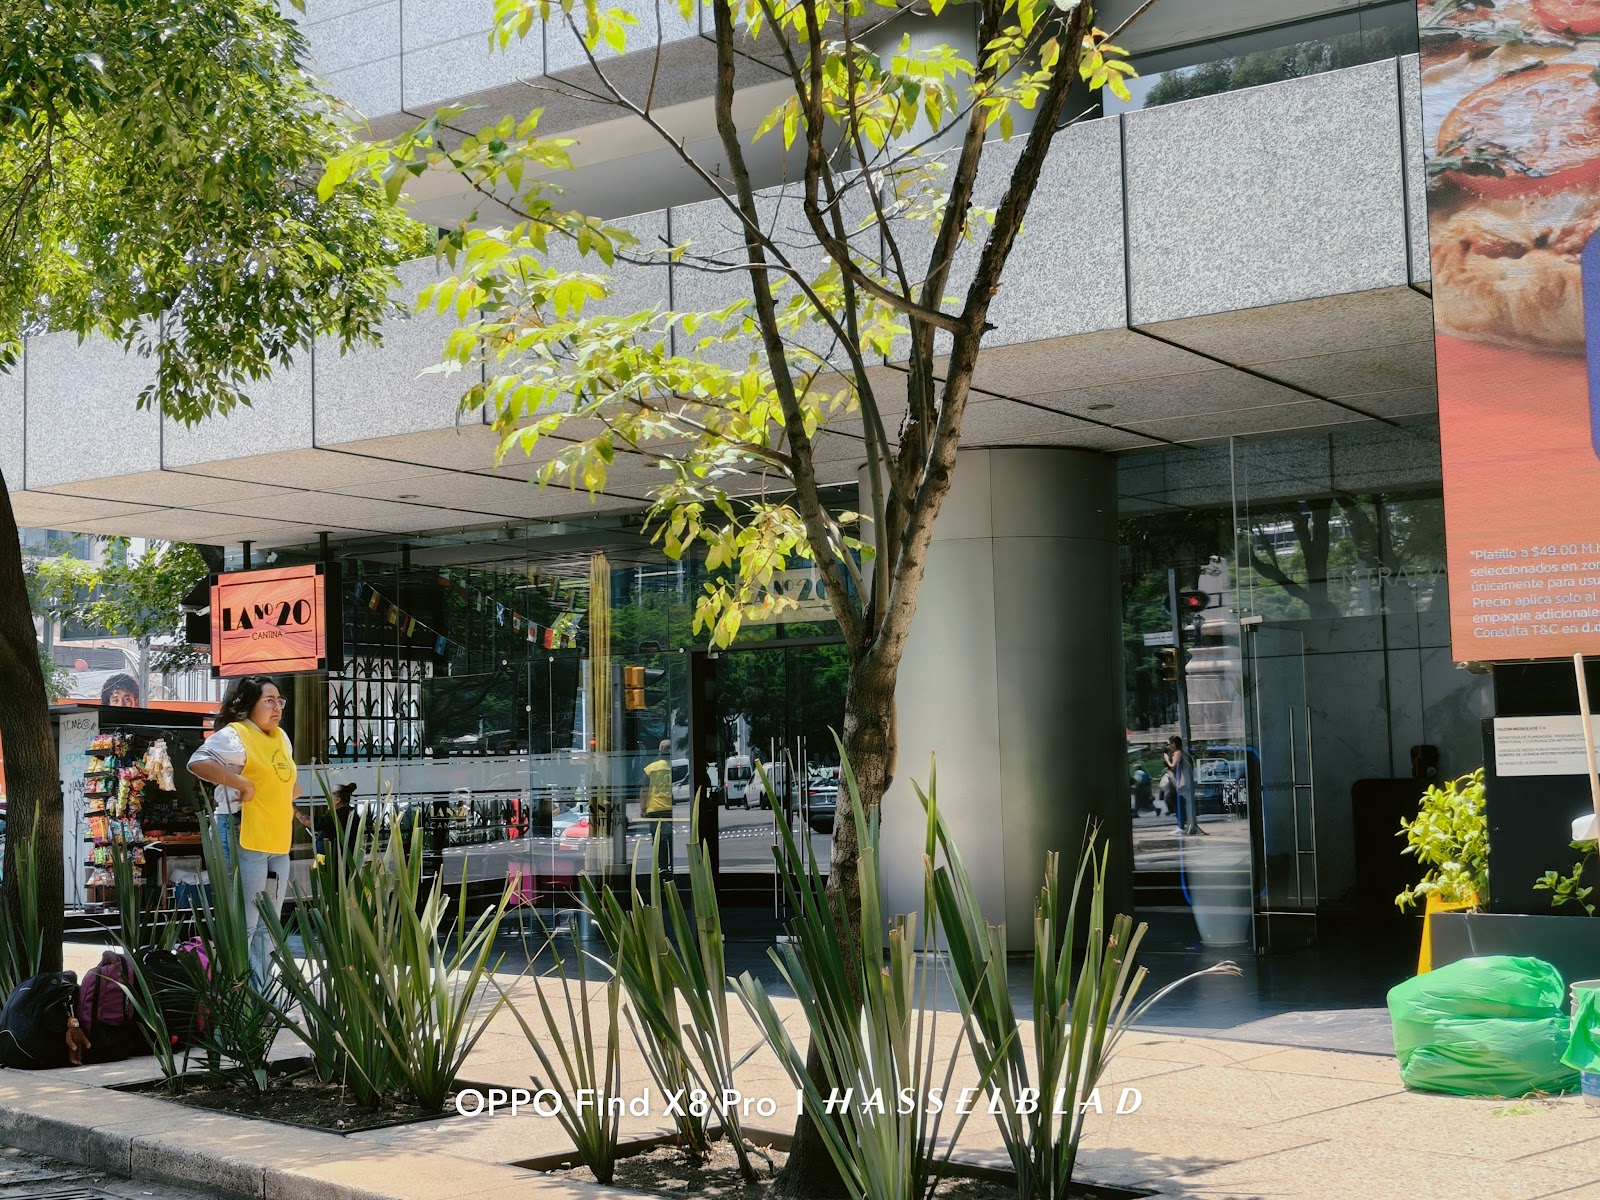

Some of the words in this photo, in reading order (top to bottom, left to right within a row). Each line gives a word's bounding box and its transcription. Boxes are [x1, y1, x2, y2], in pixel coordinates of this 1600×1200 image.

[1521, 549, 1529, 557] a
[1531, 544, 1577, 557] $49.00
[1470, 562, 1558, 577] seleccionados
[1561, 562, 1578, 572] en
[1471, 579, 1544, 592] únicamente
[1547, 578, 1575, 590] para
[1472, 596, 1511, 608] Precio
[1515, 594, 1552, 607] aplica
[1555, 592, 1581, 604] solo
[1585, 592, 1596, 602] al
[1472, 611, 1531, 624] empaque
[1535, 606, 1600, 620] adicionale
[251, 630, 283, 641] CANTINA
[1473, 626, 1529, 638] Consulta
[1531, 623, 1558, 635] T&C
[1561, 624, 1578, 634] en
